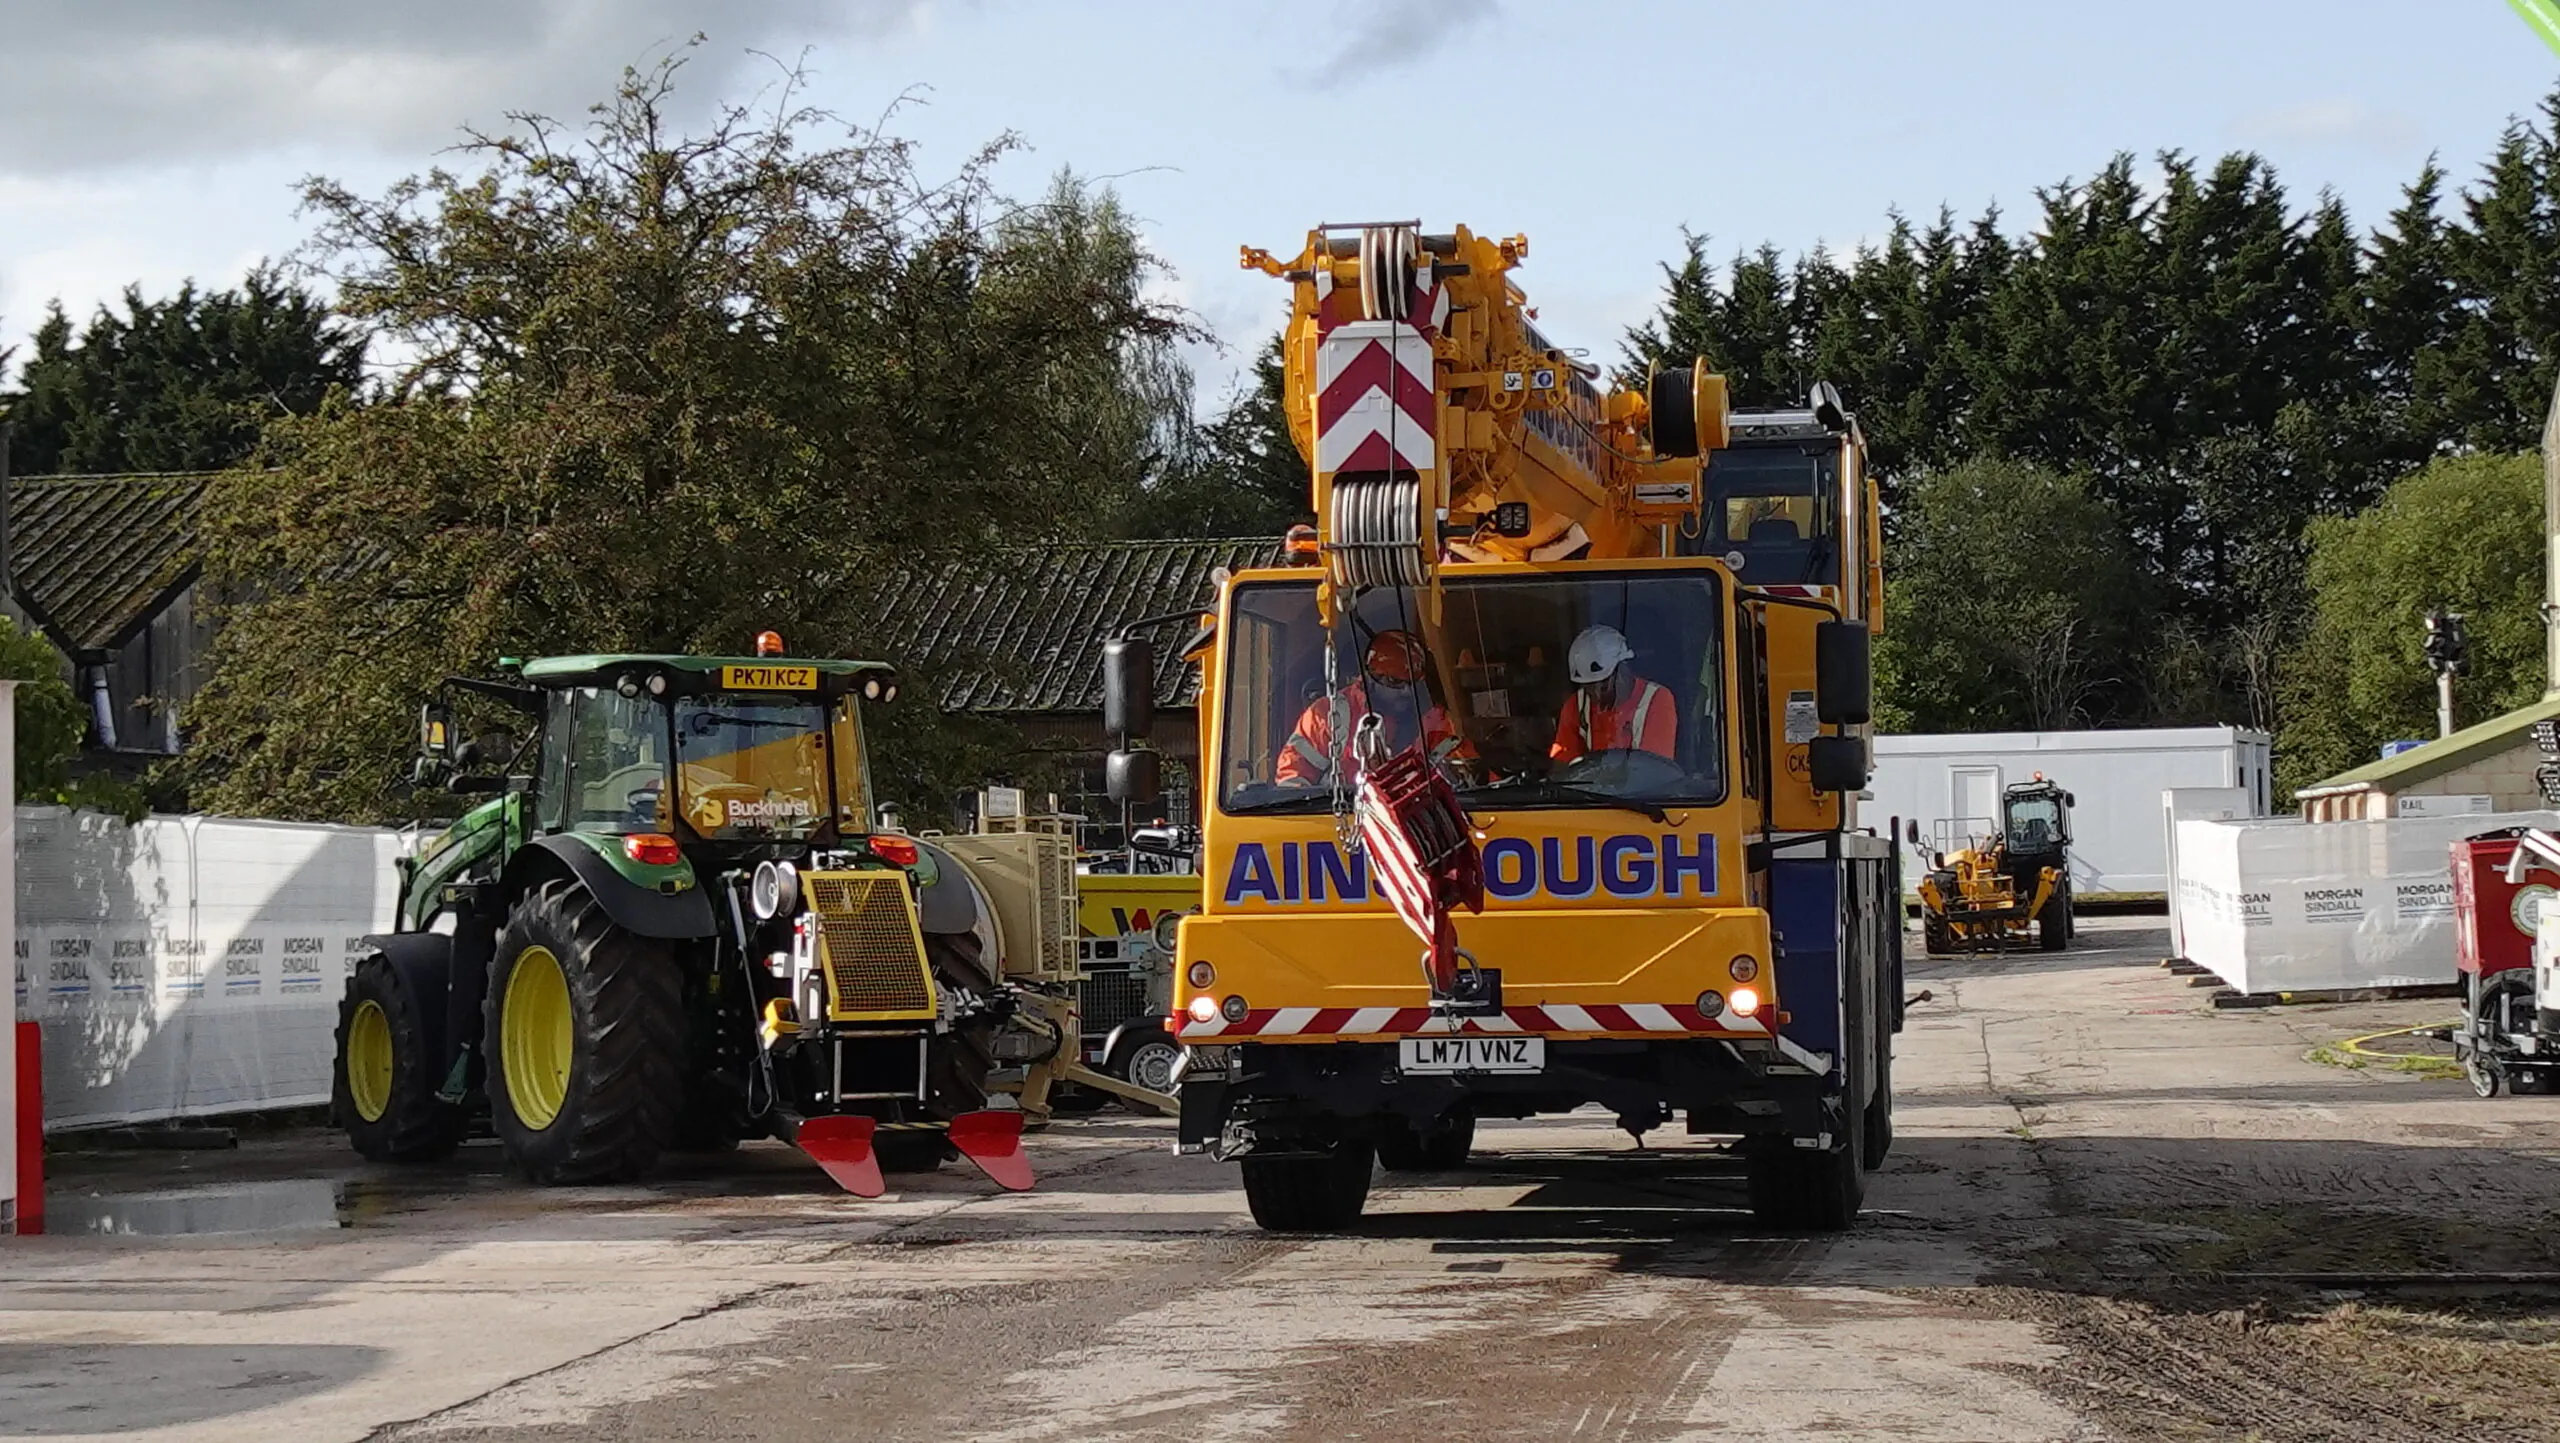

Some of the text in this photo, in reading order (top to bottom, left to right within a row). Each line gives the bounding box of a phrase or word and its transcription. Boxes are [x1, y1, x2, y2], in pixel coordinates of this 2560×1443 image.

[733, 668, 809, 686] PK71 KCZ
[728, 800, 811, 816] Buckhurst
[1223, 833, 1719, 904] AINOUGH
[2304, 888, 2363, 901] MORGAN
[2396, 884, 2454, 897] MORGAN
[2304, 900, 2362, 913] SINDALL
[226, 937, 265, 954] MORGAN
[283, 936, 324, 954] MORGAN
[281, 956, 321, 974] SINDALL
[1415, 1040, 1528, 1064] LM71 VNZ
